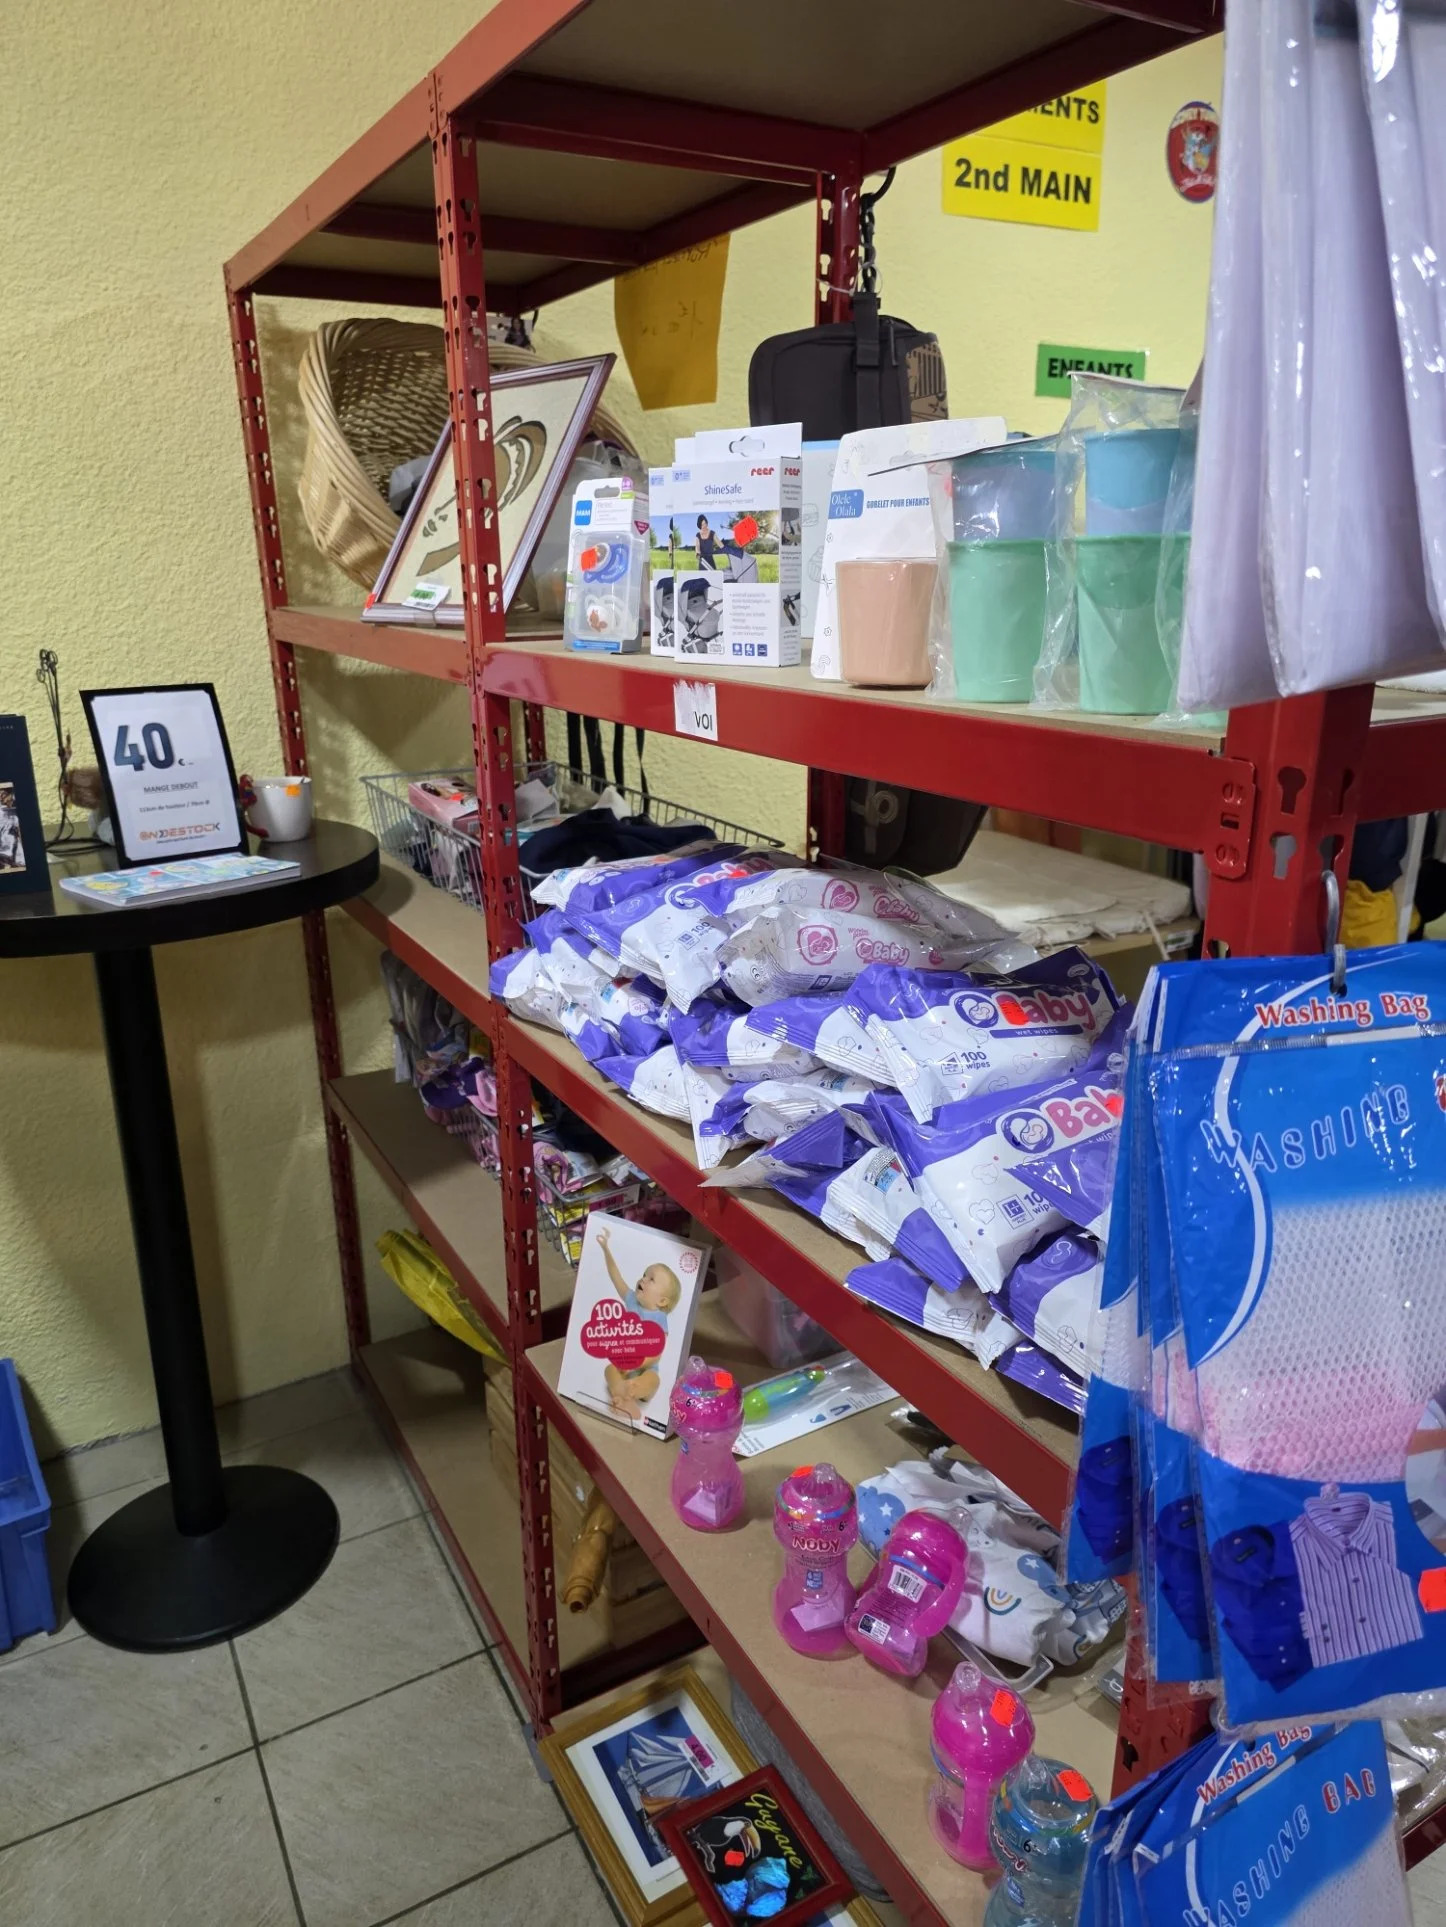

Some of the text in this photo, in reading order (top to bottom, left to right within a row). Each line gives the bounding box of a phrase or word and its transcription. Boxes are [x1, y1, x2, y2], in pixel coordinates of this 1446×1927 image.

[1034, 95, 1099, 124] ENTS
[954, 157, 1091, 204] 2nd MAIN
[1048, 357, 1133, 379] ENFANTS
[750, 466, 774, 476] reer
[704, 484, 742, 496] ShineSafe
[866, 497, 930, 509] GOBELET POUR ENFANTS
[113, 722, 175, 772] 40
[143, 781, 198, 794] MANGE DEBOUT
[691, 921, 710, 934] 100
[872, 941, 910, 967] Baby
[996, 991, 1096, 1031] aby
[1256, 992, 1431, 1029] Washing Bag
[1015, 1027, 1059, 1036] wet wipes
[961, 1051, 987, 1064] 100
[966, 1062, 991, 1070] wipes
[1199, 1084, 1410, 1173] WASHING
[1096, 1132, 1114, 1144] wip
[1024, 1190, 1044, 1206] 10
[595, 1302, 622, 1320] 100
[586, 1319, 644, 1338] activités
[1196, 1726, 1312, 1805] Washing Bag
[745, 1793, 804, 1869] Guyane
